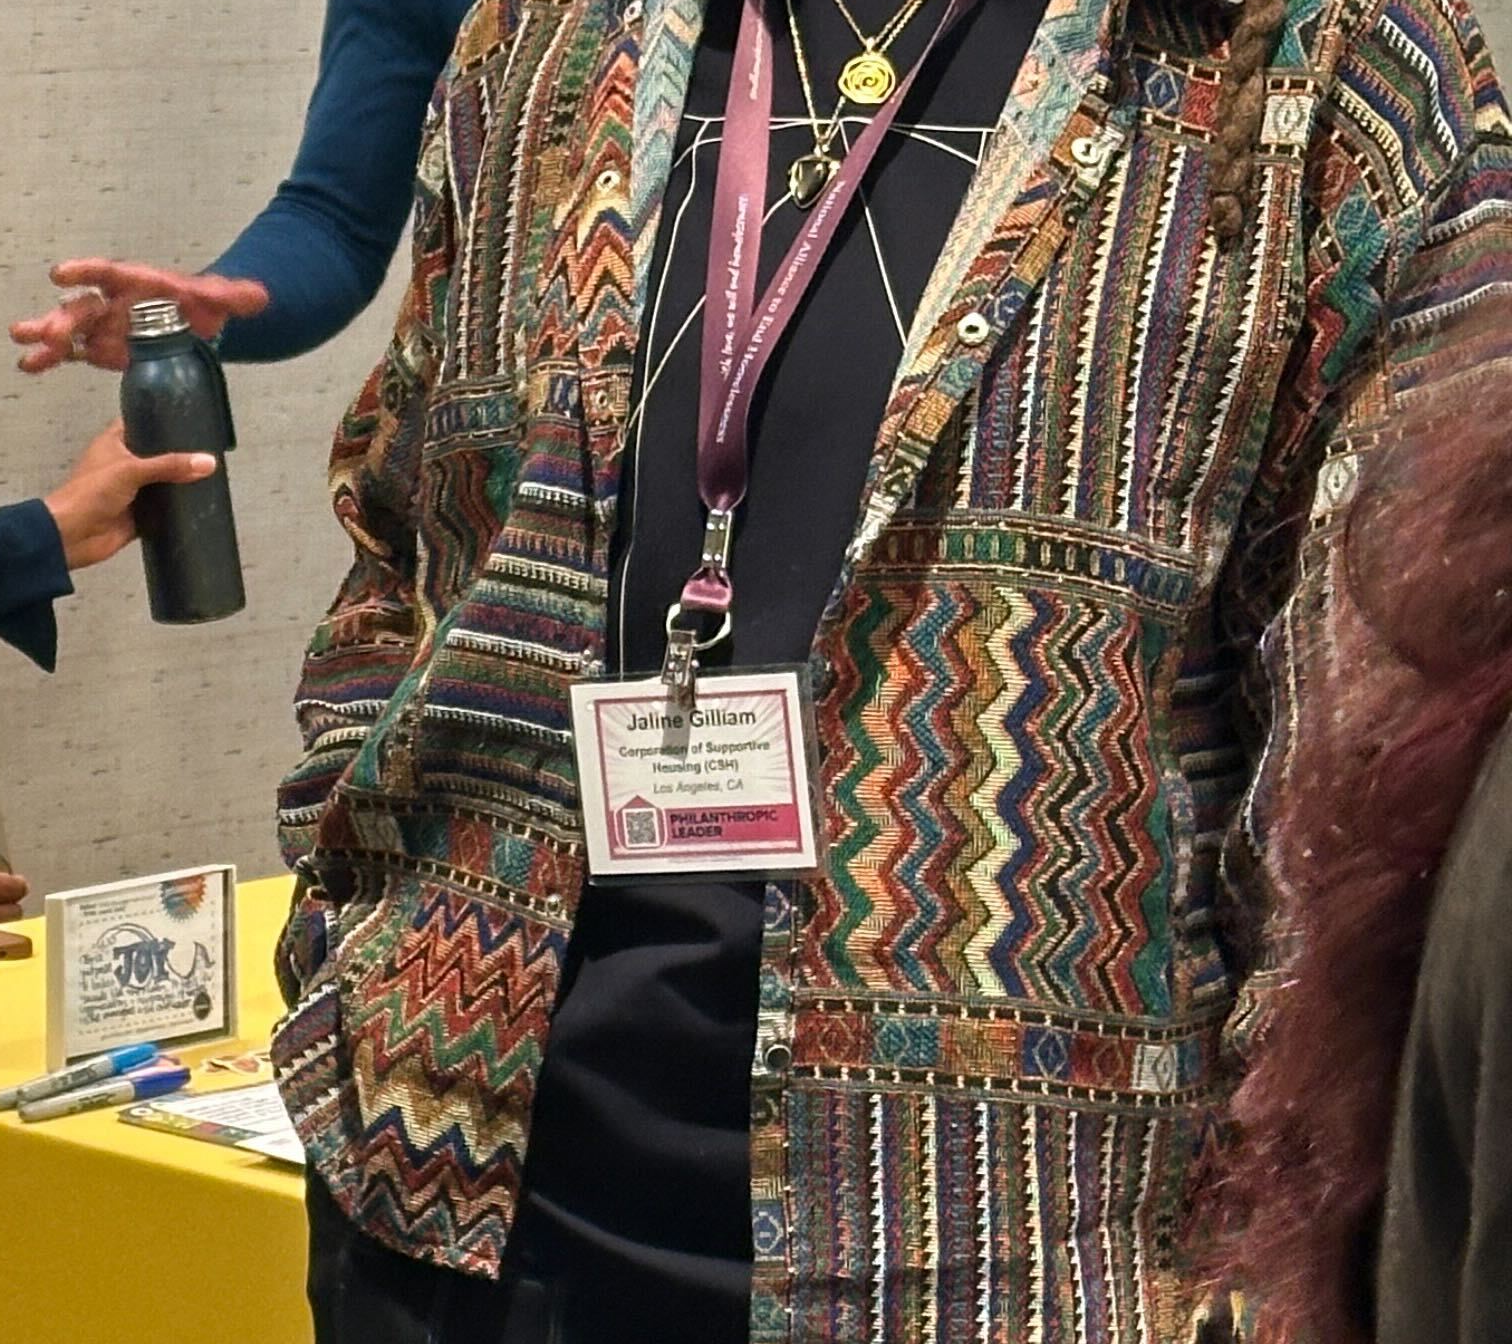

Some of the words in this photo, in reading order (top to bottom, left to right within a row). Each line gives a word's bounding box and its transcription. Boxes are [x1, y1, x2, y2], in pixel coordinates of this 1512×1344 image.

[811, 179, 847, 238] National
[778, 241, 811, 295] Alliance
[768, 298, 781, 312] to
[752, 316, 774, 343] End
[627, 713, 684, 731] Jaline
[689, 709, 757, 728] Gilliam
[691, 742, 703, 754] of
[705, 741, 770, 756] Supportive
[653, 762, 701, 775] Housing
[704, 759, 739, 774] (CSH)
[653, 783, 673, 794] Los
[727, 780, 744, 791] CA
[669, 809, 778, 825] PHILANTHROPIC
[671, 825, 723, 839] LEADER
